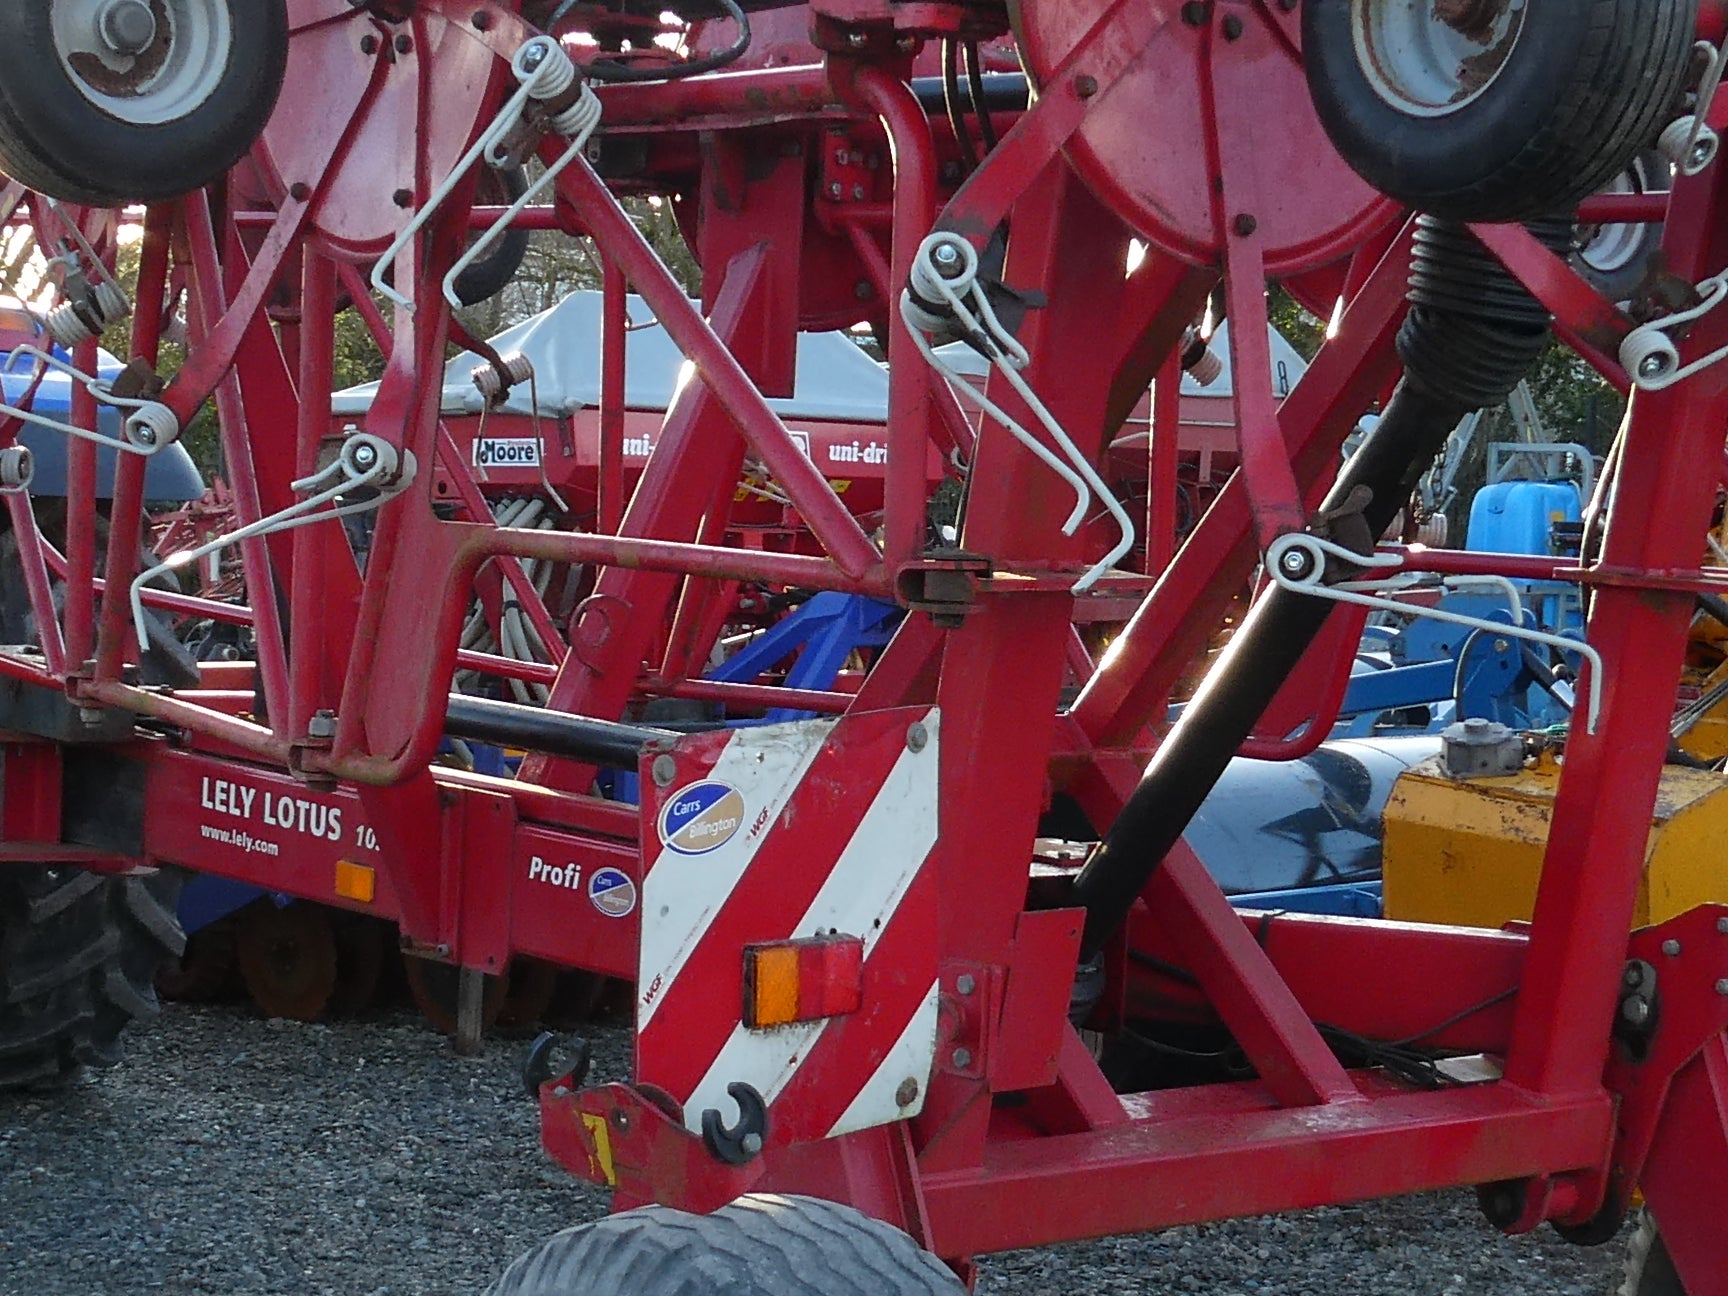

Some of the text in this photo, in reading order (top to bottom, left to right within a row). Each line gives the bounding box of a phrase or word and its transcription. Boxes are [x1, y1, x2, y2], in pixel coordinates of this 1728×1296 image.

[201, 777, 255, 818] LELY
[263, 792, 342, 841] LOTUS
[673, 799, 701, 816] Carrs
[201, 824, 279, 856] www.lely.com
[529, 856, 582, 890] Profi
